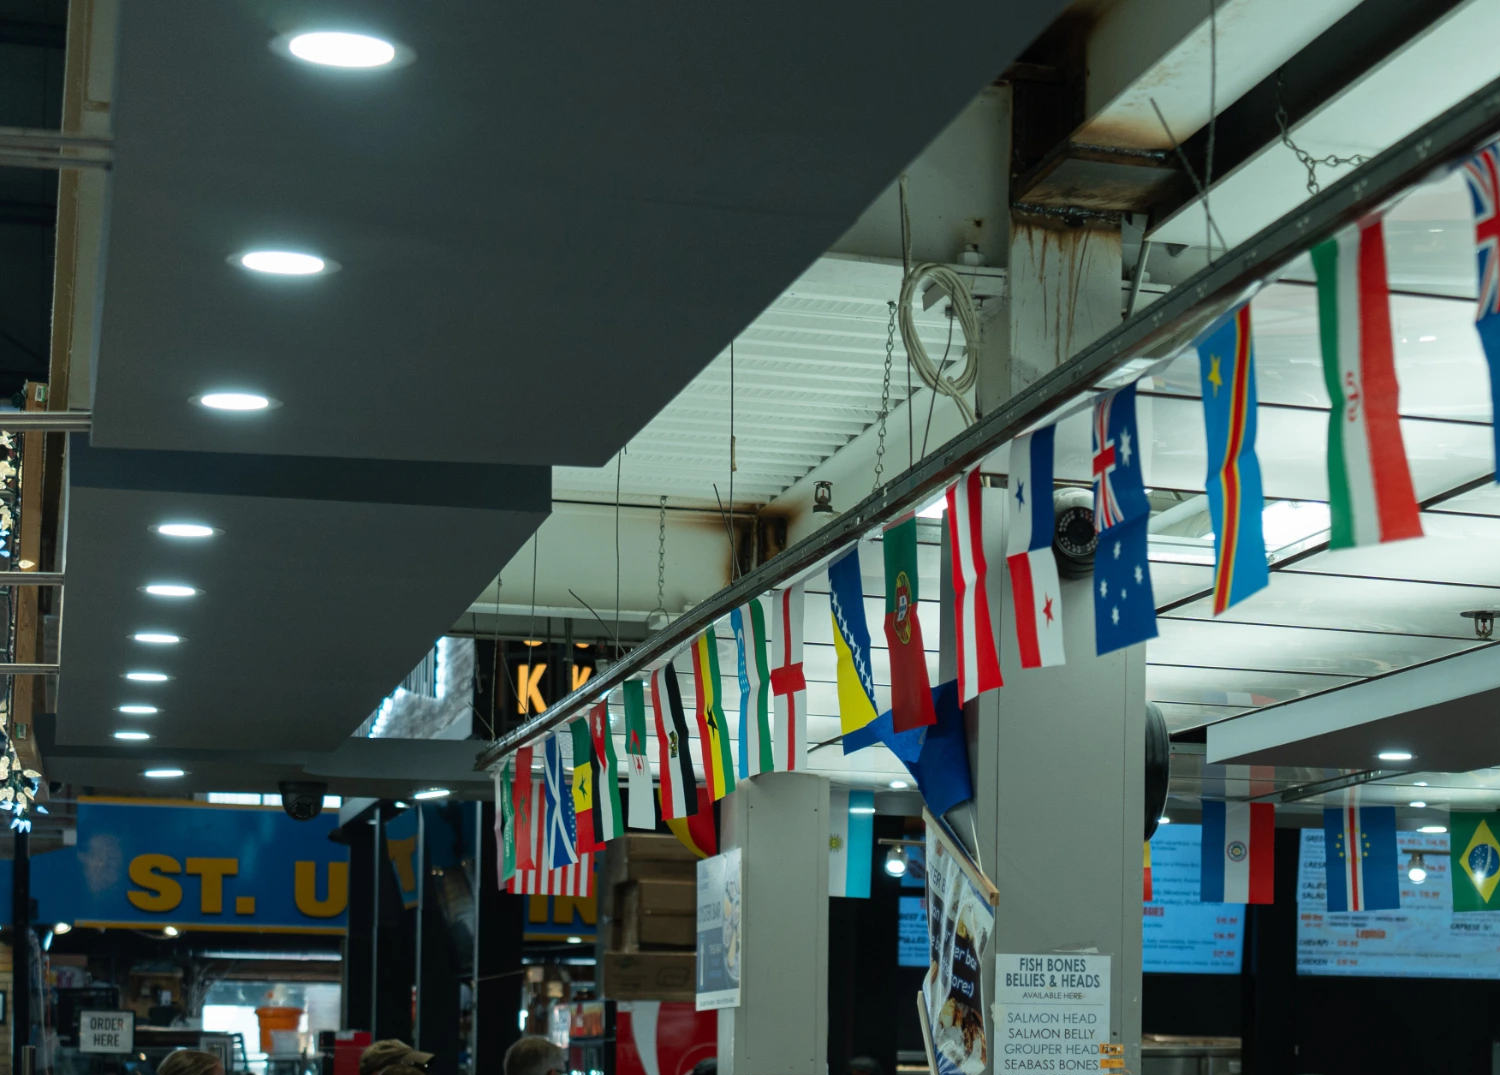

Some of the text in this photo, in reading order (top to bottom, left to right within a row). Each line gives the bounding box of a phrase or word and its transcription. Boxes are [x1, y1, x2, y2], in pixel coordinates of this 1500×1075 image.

[127, 853, 256, 915] ST.
[1020, 957, 1086, 973] FISH BONES
[1006, 973, 1101, 988] BELLIES & HEADS
[1022, 991, 1083, 1000] AVAILABLE HERE
[90, 1017, 124, 1031] ORDER
[1007, 1012, 1097, 1024] SALMON HEAD
[93, 1033, 120, 1047] HERE
[1008, 1027, 1096, 1040] SALMON BELLY
[1004, 1043, 1100, 1055] GROUPER HEAD
[1004, 1058, 1055, 1070] SEABASS
[1059, 1059, 1099, 1070] BONES
